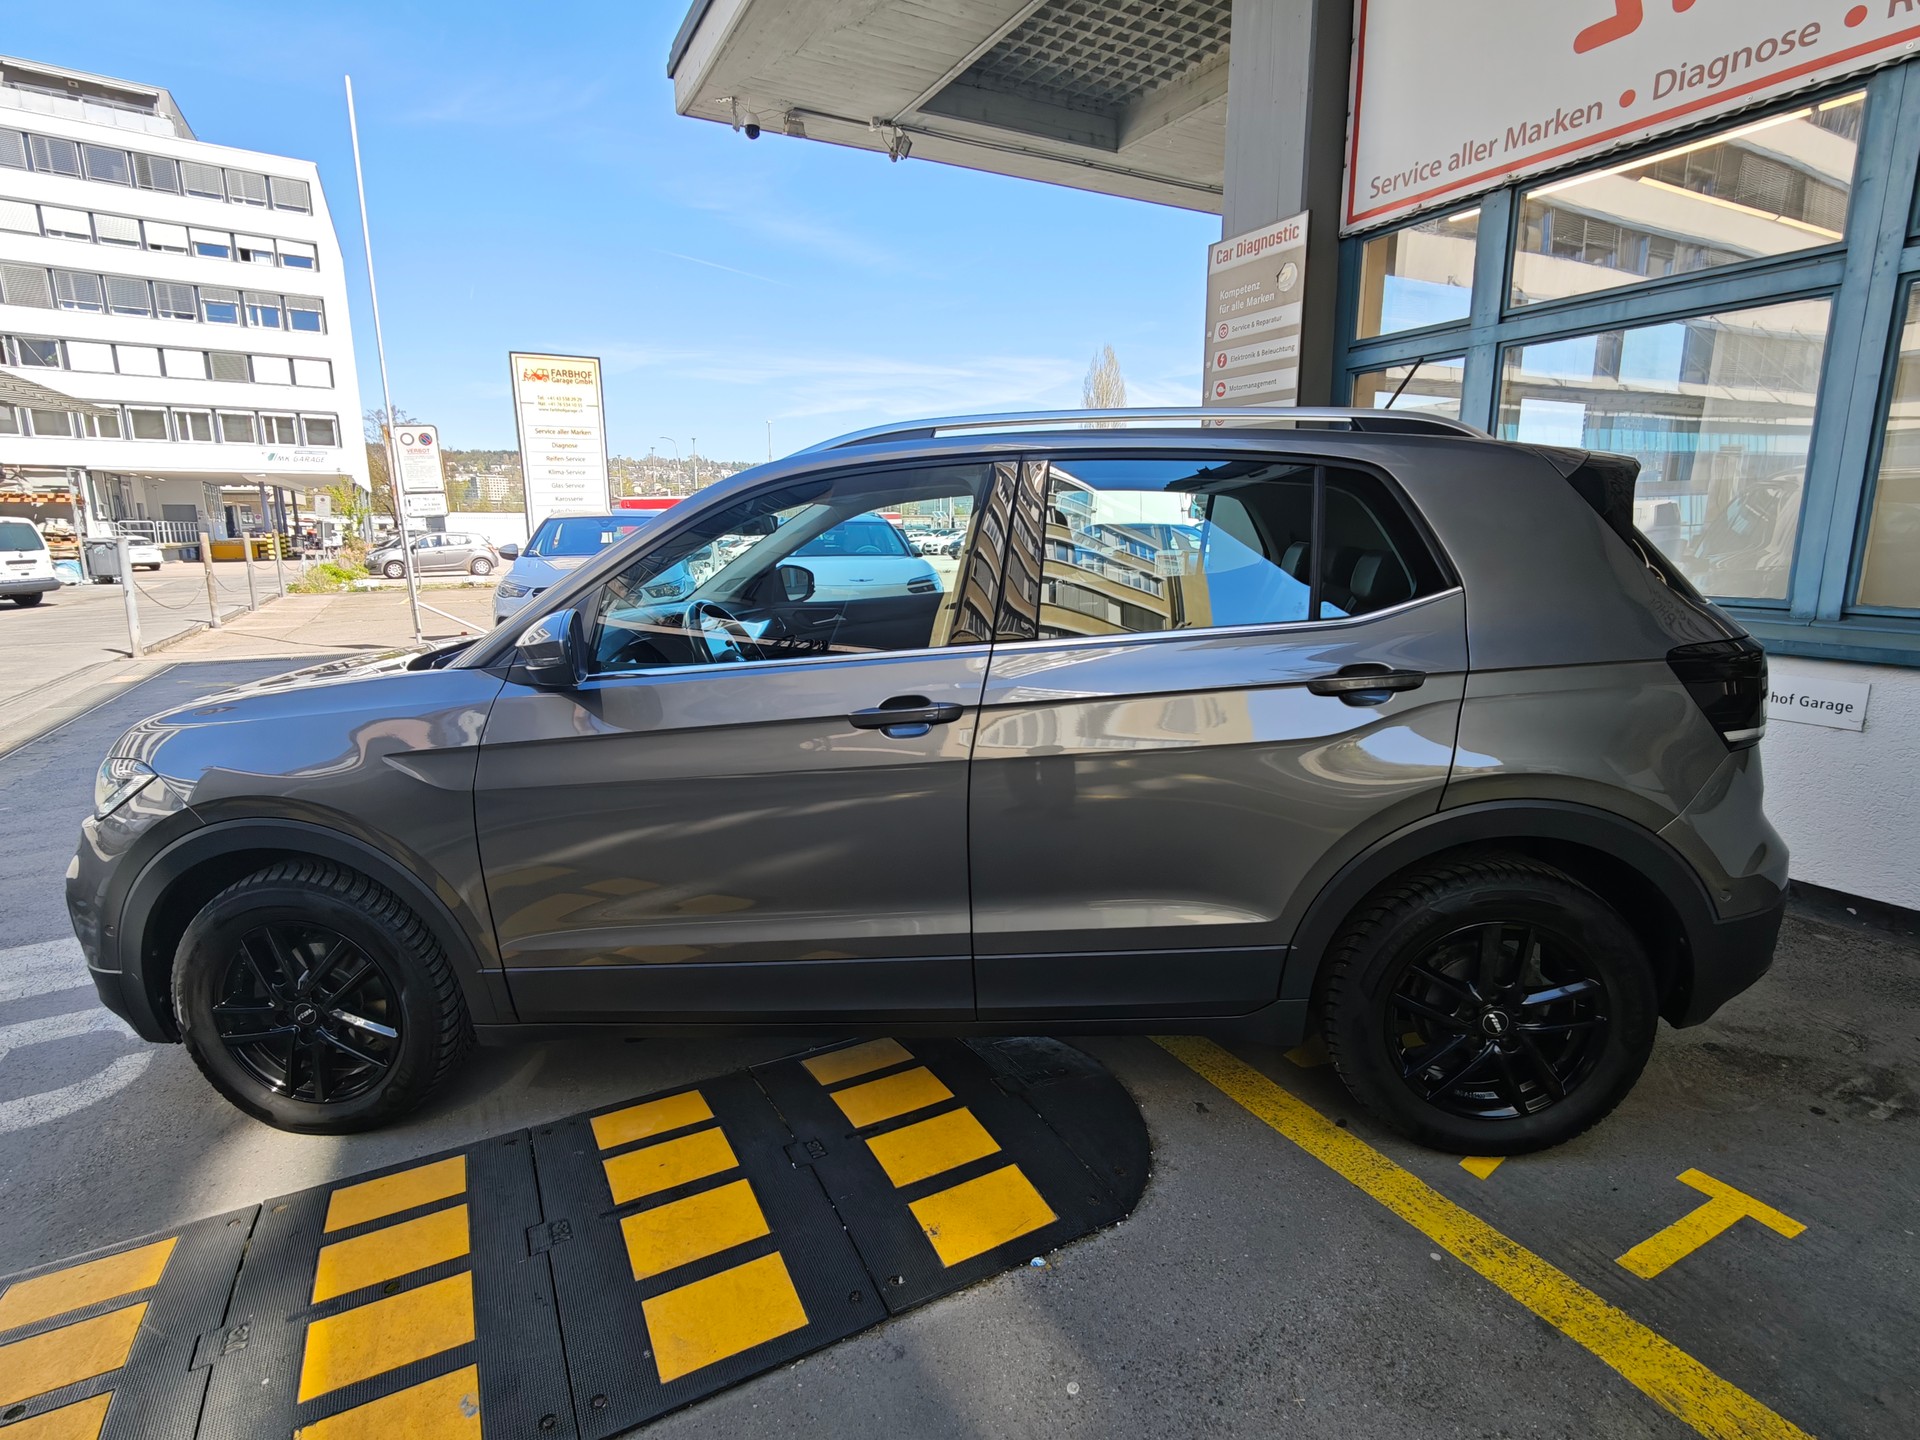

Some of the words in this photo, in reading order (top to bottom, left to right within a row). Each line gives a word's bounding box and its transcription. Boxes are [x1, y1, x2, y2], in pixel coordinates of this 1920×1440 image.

[1369, 159, 1442, 200] Service
[1447, 137, 1498, 172] aller
[1503, 100, 1603, 153] Marken
[1652, 21, 1822, 101] Diagnose
[1216, 247, 1234, 265] Car
[1236, 223, 1300, 258] Diagnostic
[1220, 281, 1261, 301] Kompetenz
[1219, 303, 1230, 315] für
[1231, 301, 1245, 312] alle
[1246, 292, 1275, 308] Marken
[1231, 323, 1250, 333] Service
[1256, 315, 1282, 328] Reparatur
[1230, 351, 1256, 363] Elektronik
[1256, 350, 1260, 358] &
[1261, 344, 1295, 357] Beleuchtung
[550, 369, 592, 379] FARBHOF
[551, 377, 573, 385] Garage
[1229, 378, 1277, 392] Motormanagement
[1799, 695, 1854, 715] Garage
